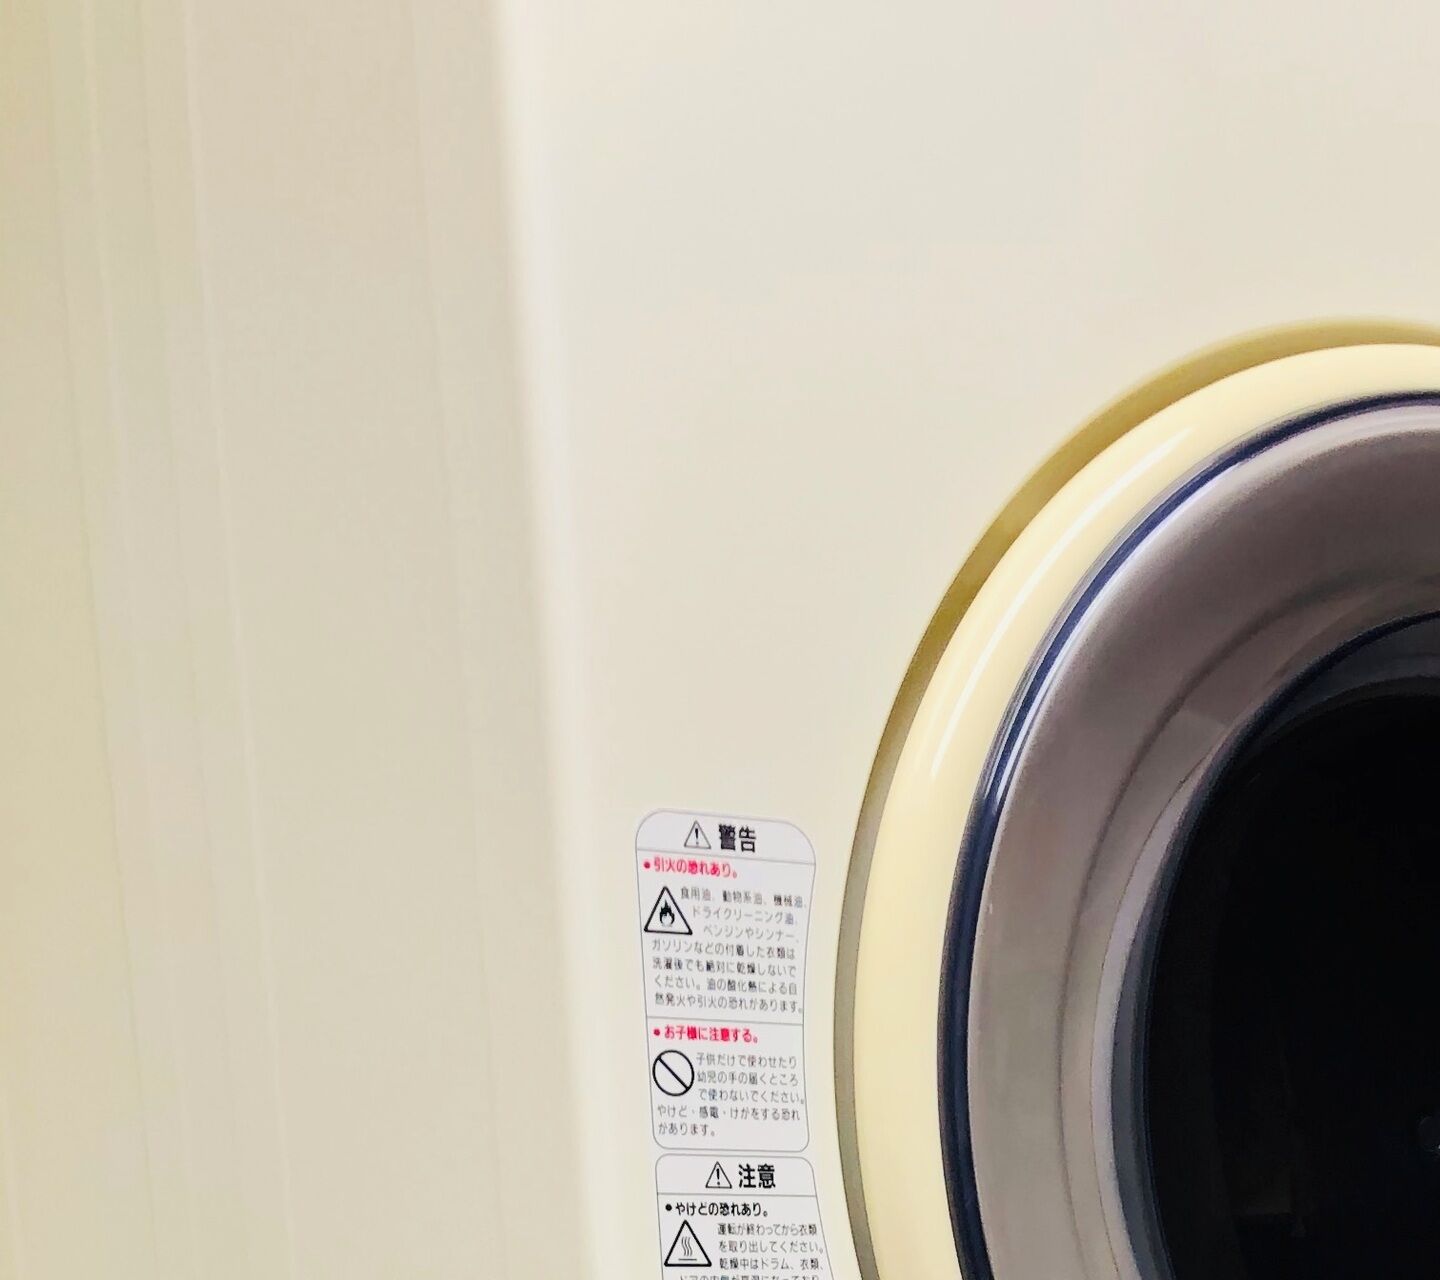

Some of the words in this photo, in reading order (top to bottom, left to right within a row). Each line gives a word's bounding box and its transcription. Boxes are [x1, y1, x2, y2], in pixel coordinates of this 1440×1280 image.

[718, 823, 757, 853] 警告
[738, 1163, 776, 1189] 注意
[675, 1202, 768, 1217] やけどの恐れあり。
